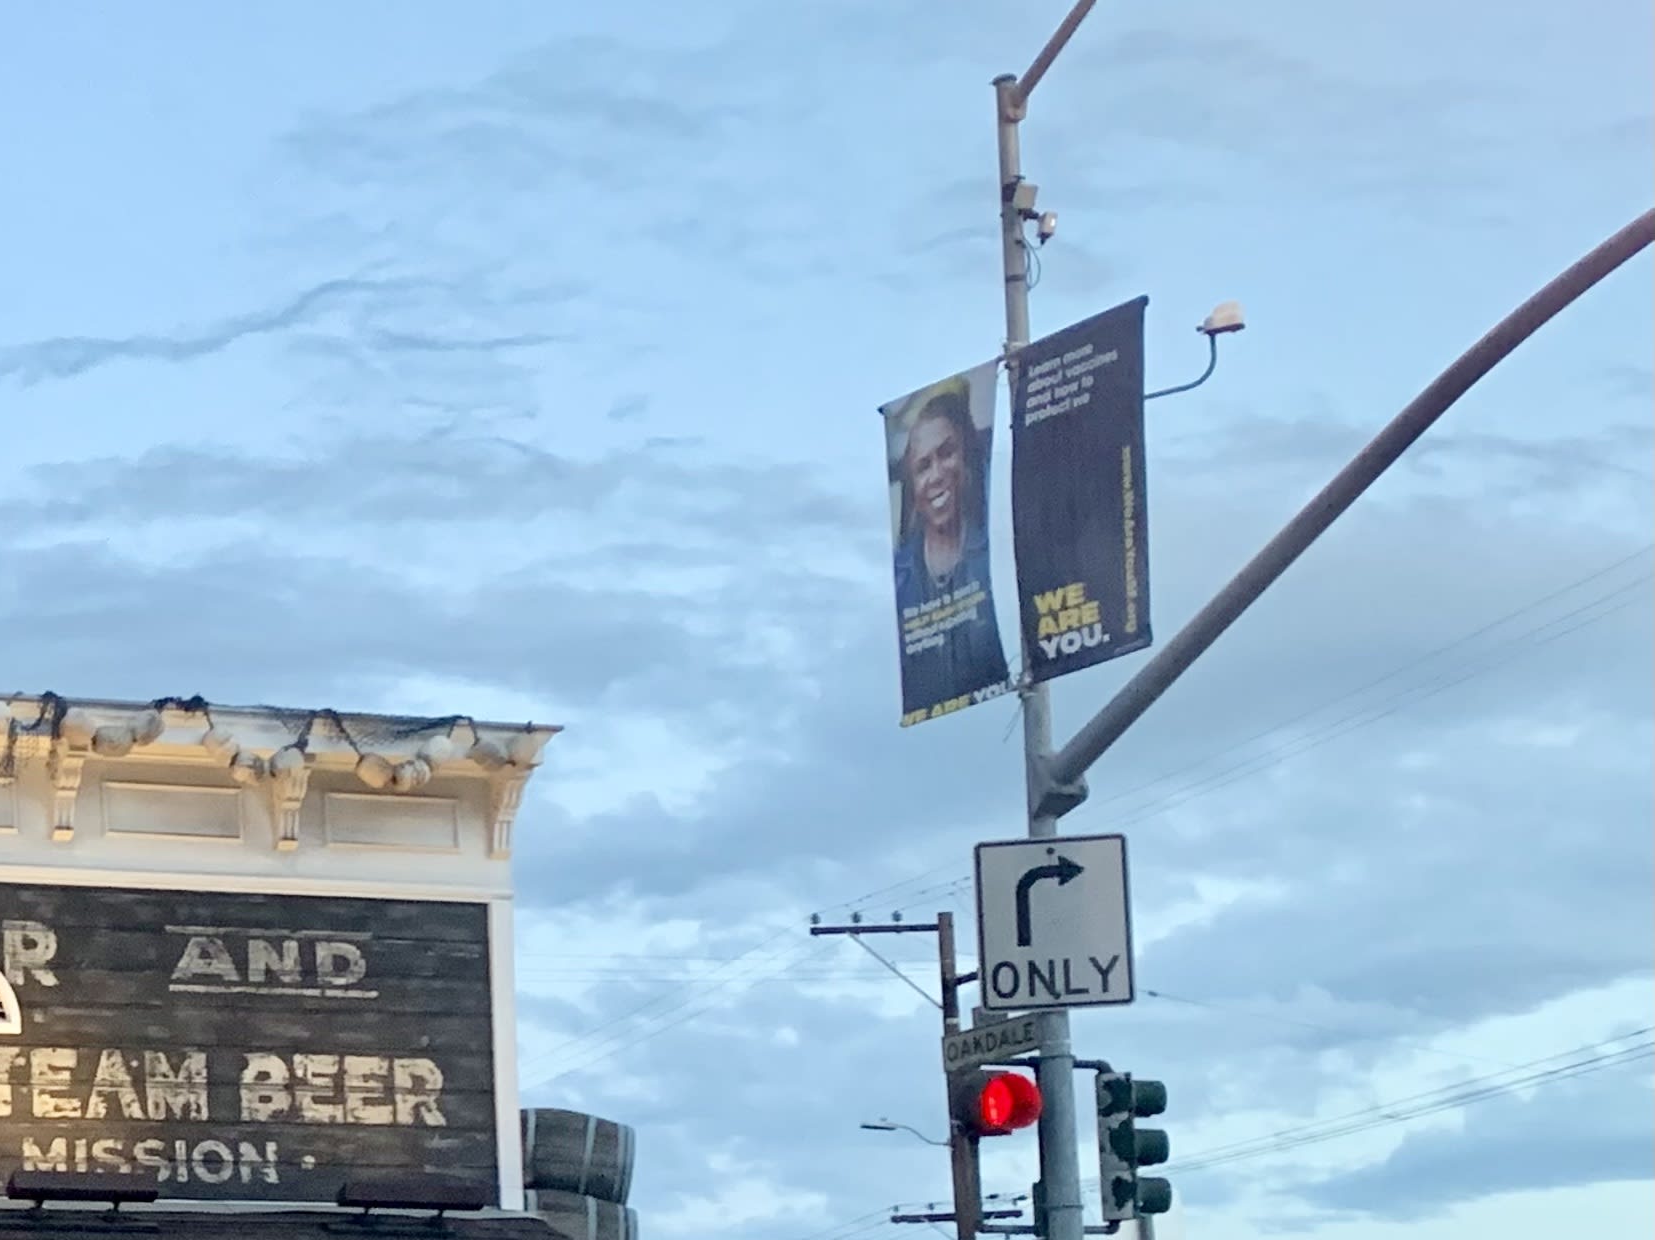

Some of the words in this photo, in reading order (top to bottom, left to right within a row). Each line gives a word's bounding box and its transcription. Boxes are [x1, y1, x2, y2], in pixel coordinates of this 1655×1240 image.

[1033, 582, 1085, 615] WE
[1037, 600, 1101, 640] ARE
[1039, 622, 1110, 660] YOU.
[170, 936, 367, 986] AND
[992, 954, 1120, 1000] ONLY
[946, 1021, 1035, 1063] OAKDALE
[240, 1051, 446, 1128] BEER
[22, 1137, 279, 1186] MISSION
